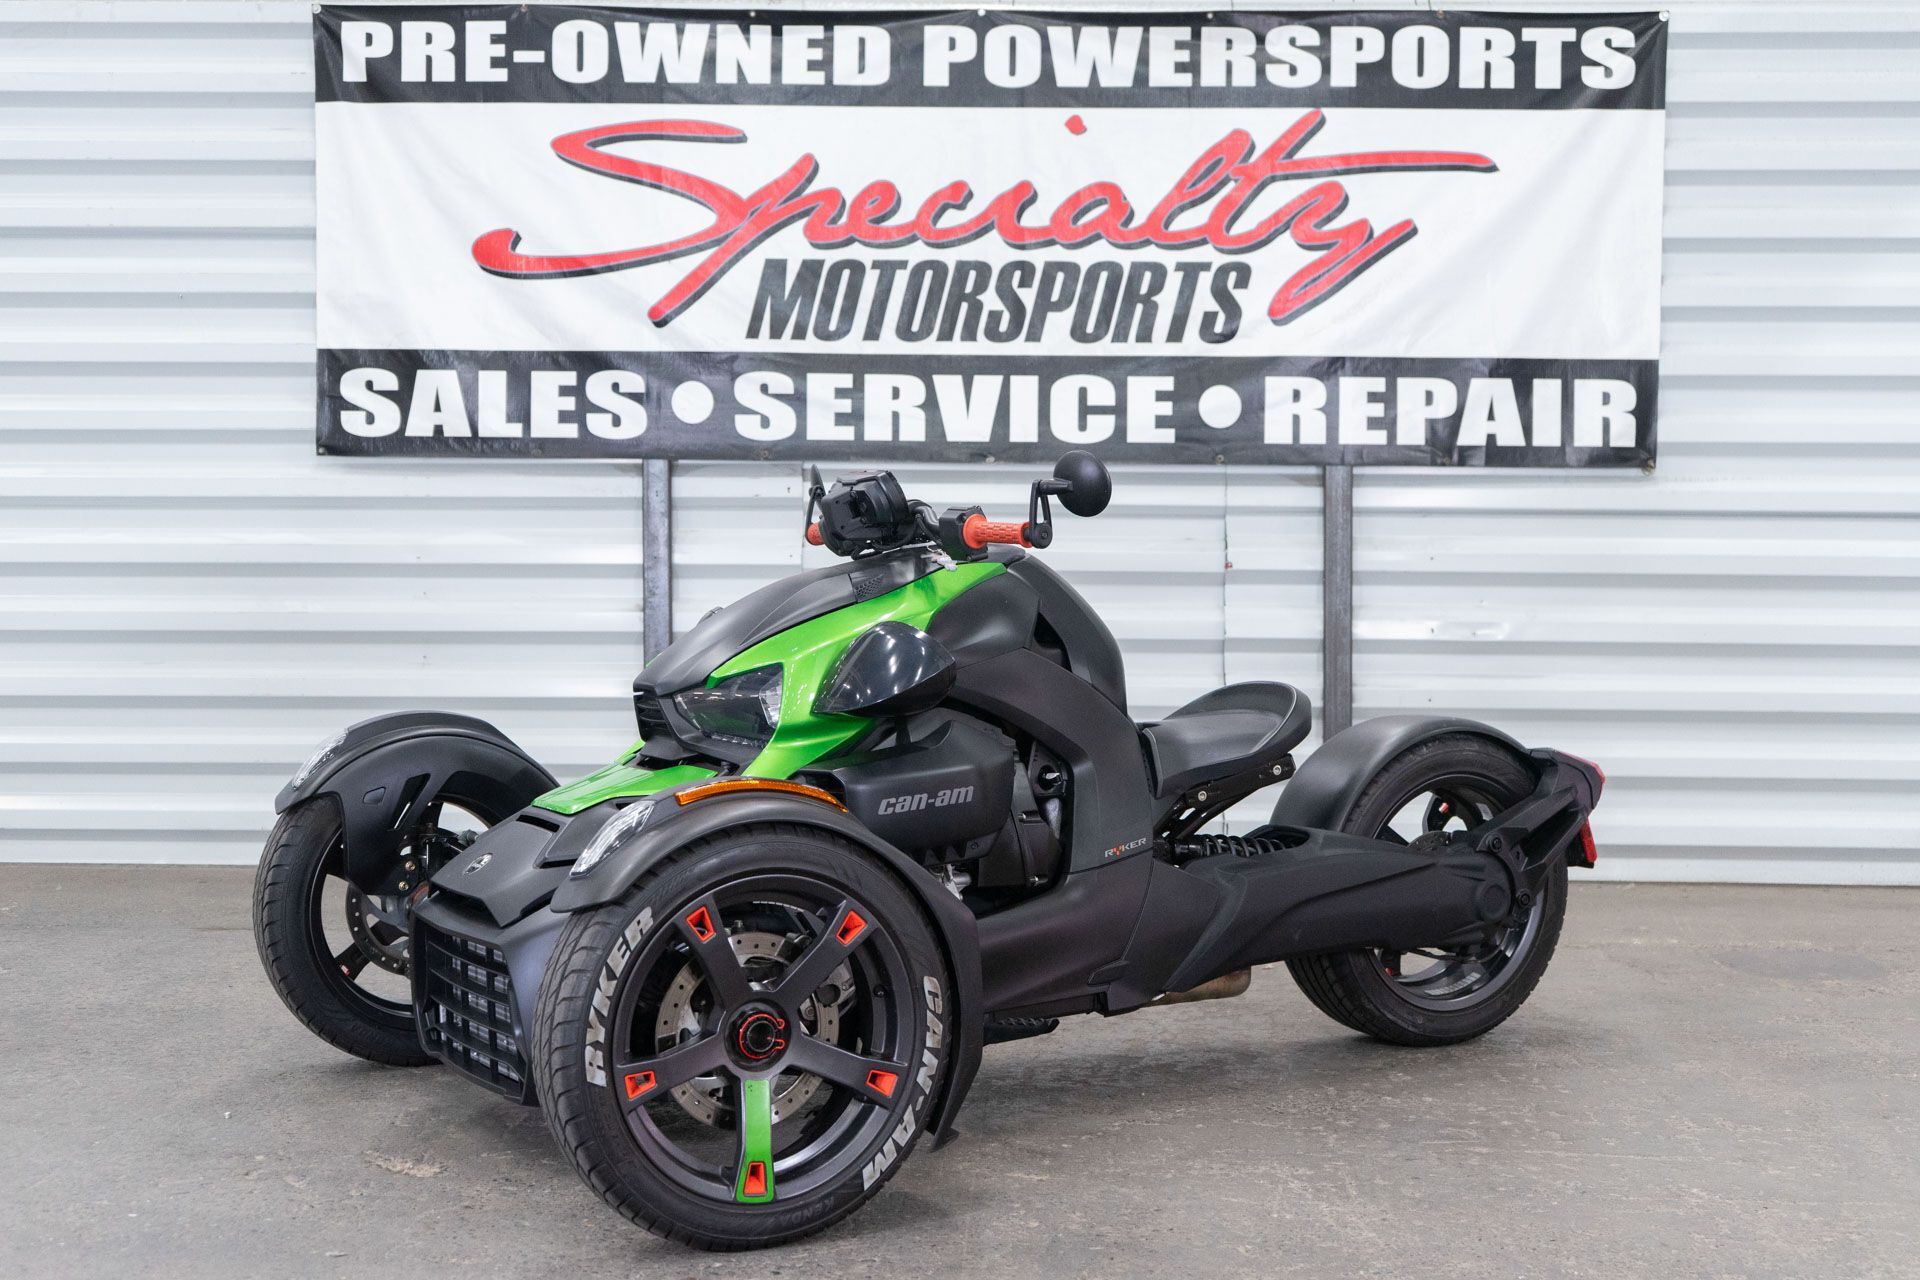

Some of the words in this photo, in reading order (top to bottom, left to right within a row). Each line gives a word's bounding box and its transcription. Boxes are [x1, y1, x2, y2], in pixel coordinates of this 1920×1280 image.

[341, 20, 891, 87] PRE-OWNED
[923, 25, 1637, 90] POWERSPORTS
[471, 108, 1499, 328] Specialty
[745, 257, 1252, 345] MOTORSPORTS
[339, 367, 648, 439] SALES
[734, 371, 1176, 445] SERVICE
[1264, 376, 1637, 448] REPAIR
[878, 785, 975, 816] can-am
[1104, 837, 1147, 859] RYKER
[585, 906, 655, 1087] RYKER
[863, 976, 946, 1191] CAN-AM
